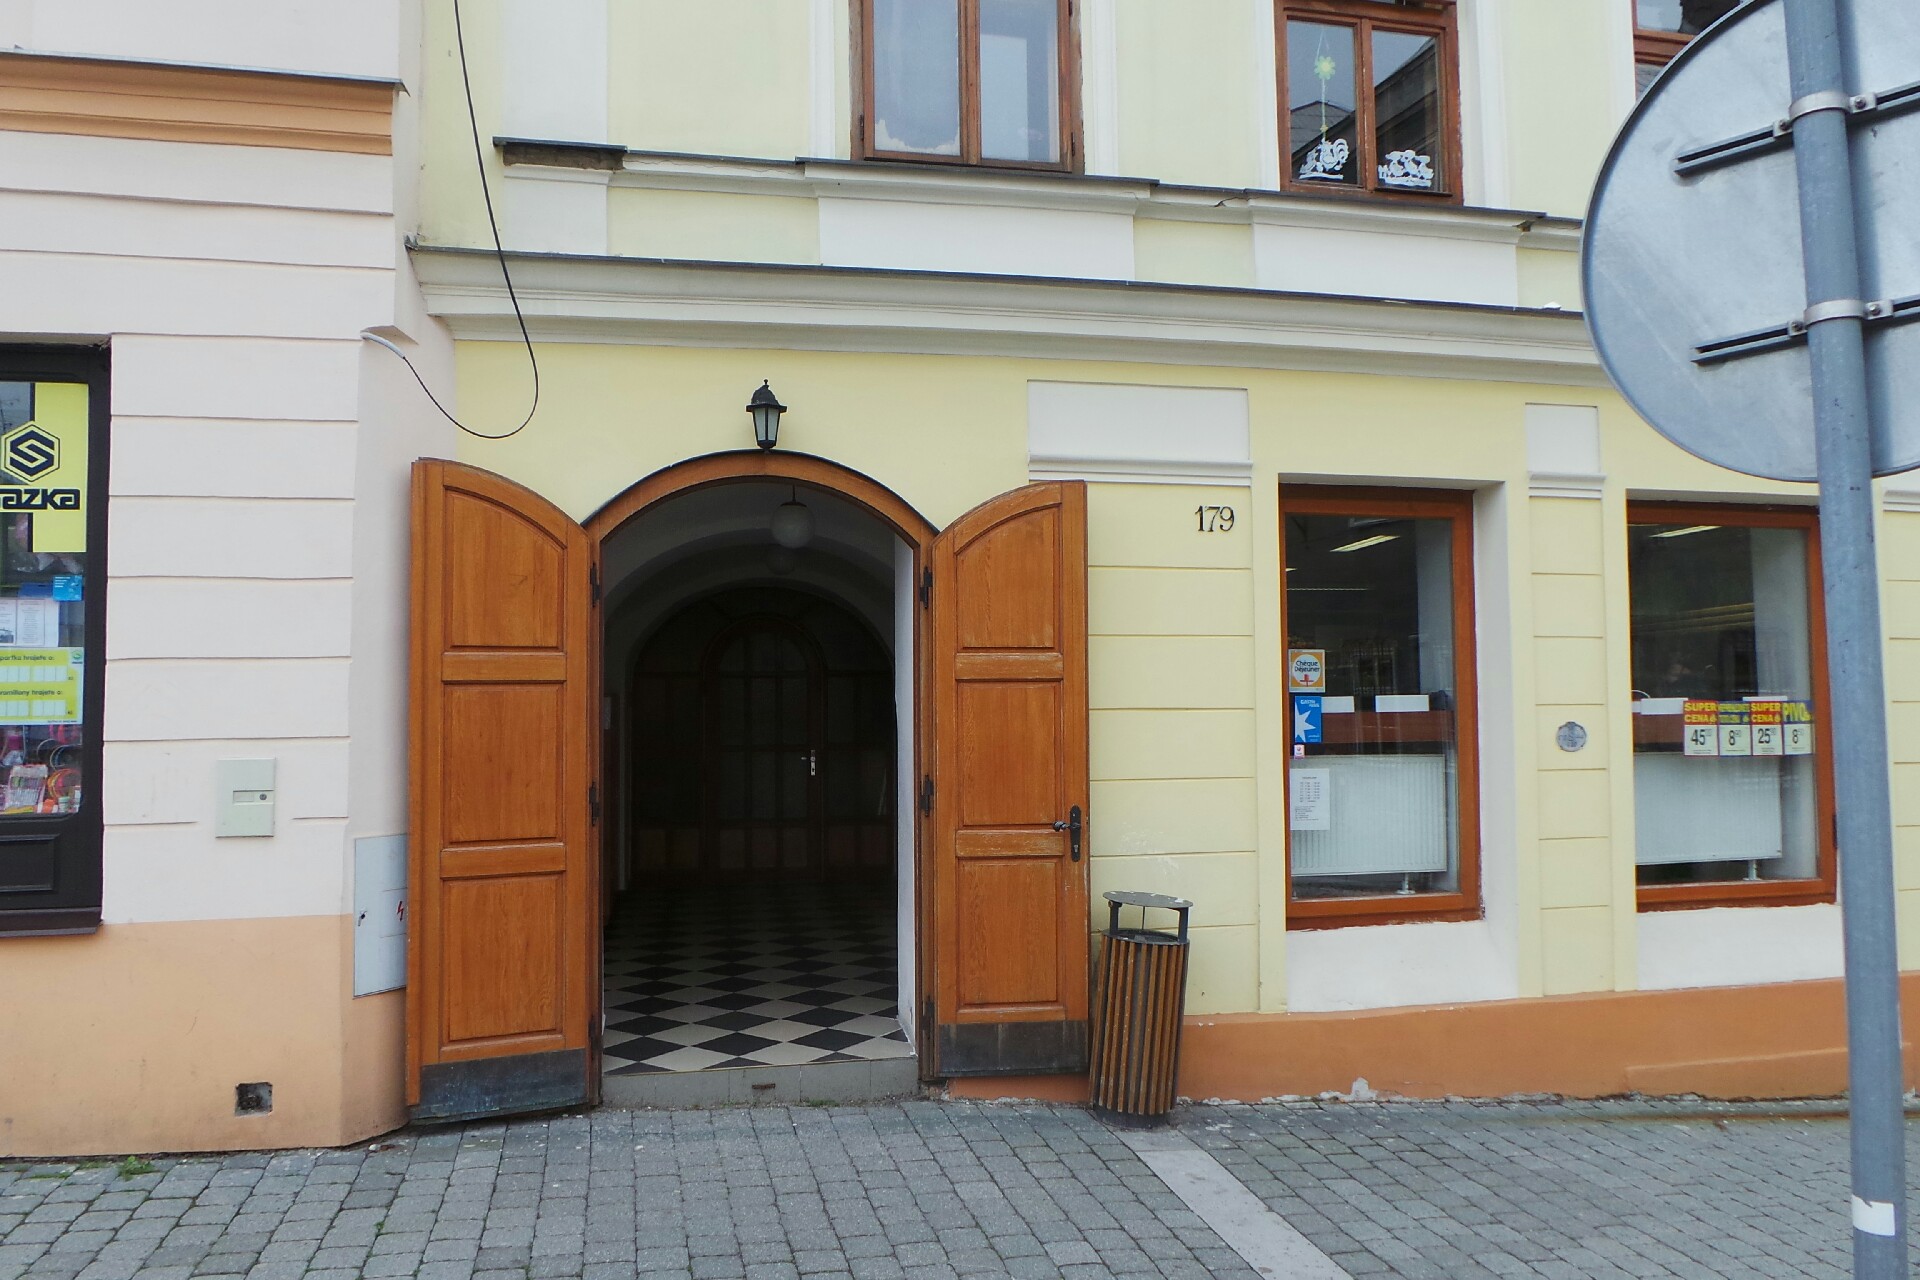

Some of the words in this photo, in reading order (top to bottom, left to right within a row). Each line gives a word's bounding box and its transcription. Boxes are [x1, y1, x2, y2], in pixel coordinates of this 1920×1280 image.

[1195, 505, 1235, 532] 179
[1685, 702, 1718, 712] SUPER
[1751, 702, 1781, 712] SUPER
[1684, 713, 1709, 723] CENA
[1751, 713, 1774, 722] CENA
